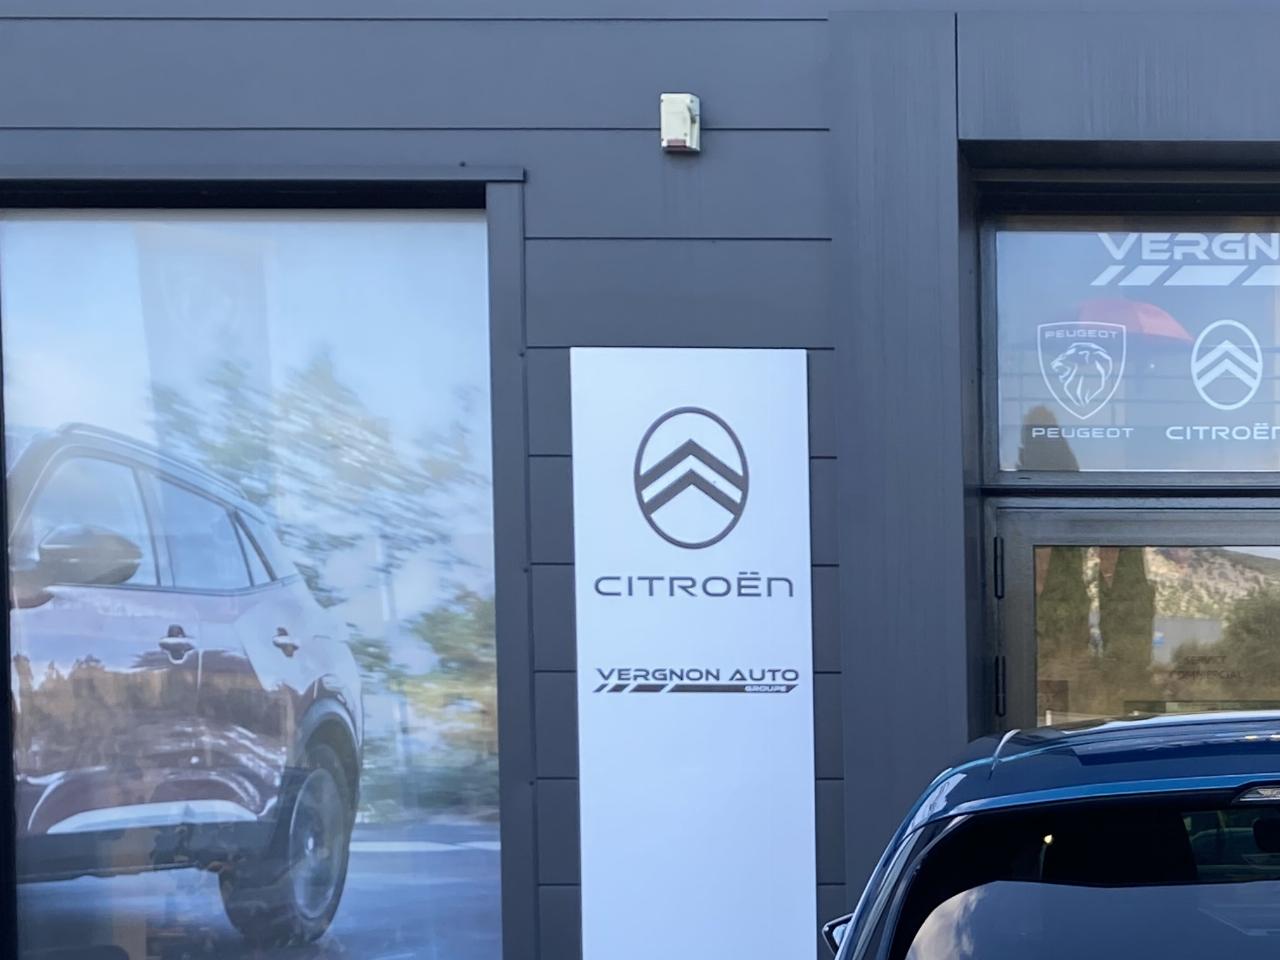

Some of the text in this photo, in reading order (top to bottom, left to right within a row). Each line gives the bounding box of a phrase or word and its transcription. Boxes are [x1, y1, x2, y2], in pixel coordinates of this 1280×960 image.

[1044, 330, 1118, 340] PEUGEOT
[1032, 427, 1134, 439] PEUGEOT
[595, 668, 799, 681] VERGNON AUTO
